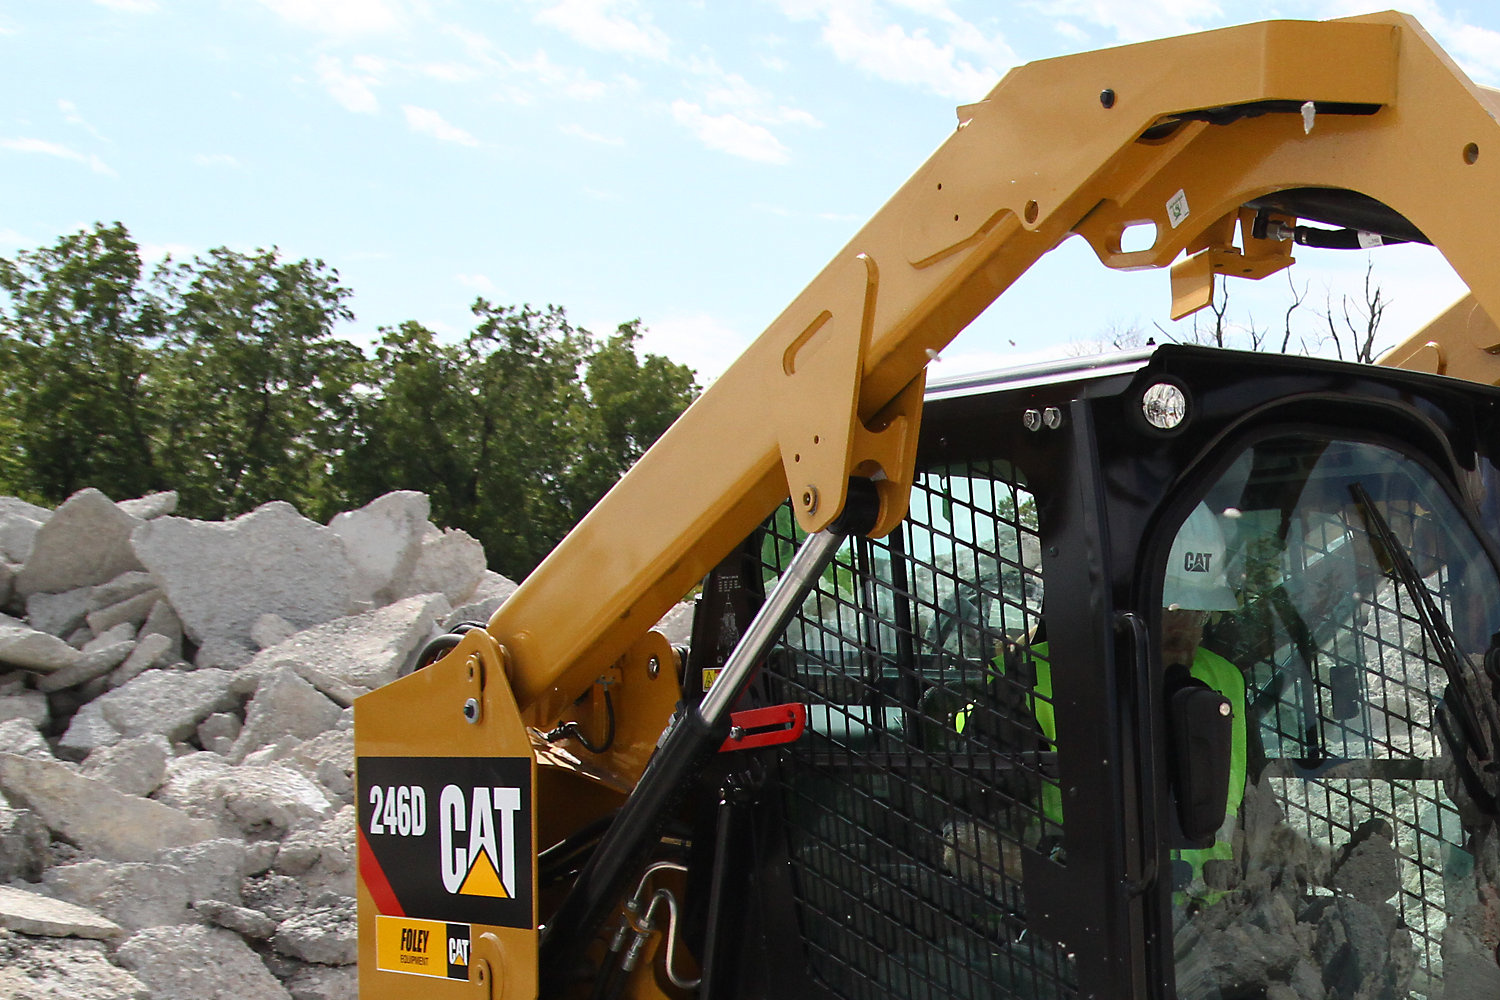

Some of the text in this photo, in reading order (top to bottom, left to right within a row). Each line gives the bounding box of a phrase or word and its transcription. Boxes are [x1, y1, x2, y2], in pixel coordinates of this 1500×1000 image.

[1184, 551, 1213, 573] CAT
[369, 783, 522, 900] 246D CAT
[400, 928, 430, 954] FOLEY
[448, 936, 471, 967] CAT
